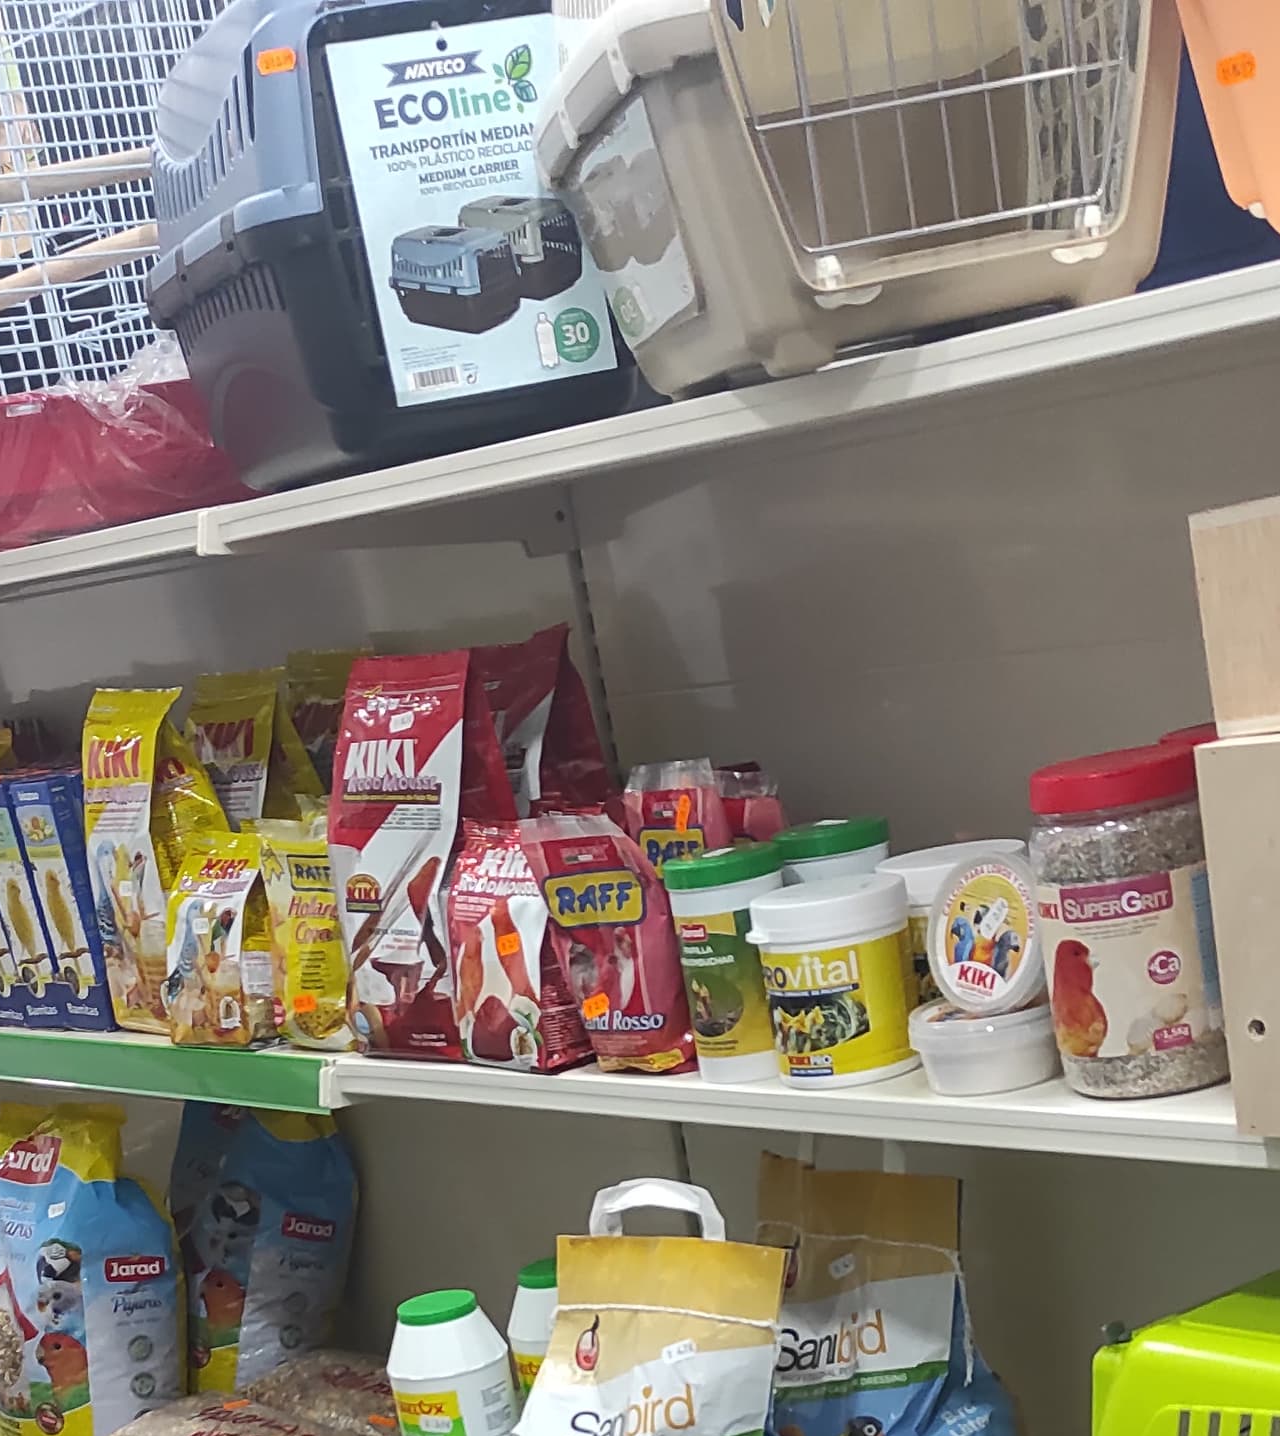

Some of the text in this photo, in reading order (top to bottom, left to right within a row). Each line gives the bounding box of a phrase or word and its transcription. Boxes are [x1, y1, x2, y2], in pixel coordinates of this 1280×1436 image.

[404, 58, 466, 80] NAYECO
[374, 87, 511, 130] ECOline
[369, 129, 477, 160] TRANSPORTÍN
[477, 139, 534, 158] RECICLAD
[418, 159, 520, 184] MEDIUM CARRIER
[561, 322, 590, 346] 30
[87, 737, 142, 780] KIKI
[343, 738, 418, 780] KIKI
[555, 881, 636, 916] RAFF
[763, 949, 860, 989] ROvital
[958, 964, 997, 990] KIKI
[287, 1216, 335, 1238] Jarad
[110, 1260, 161, 1278] Jarad
